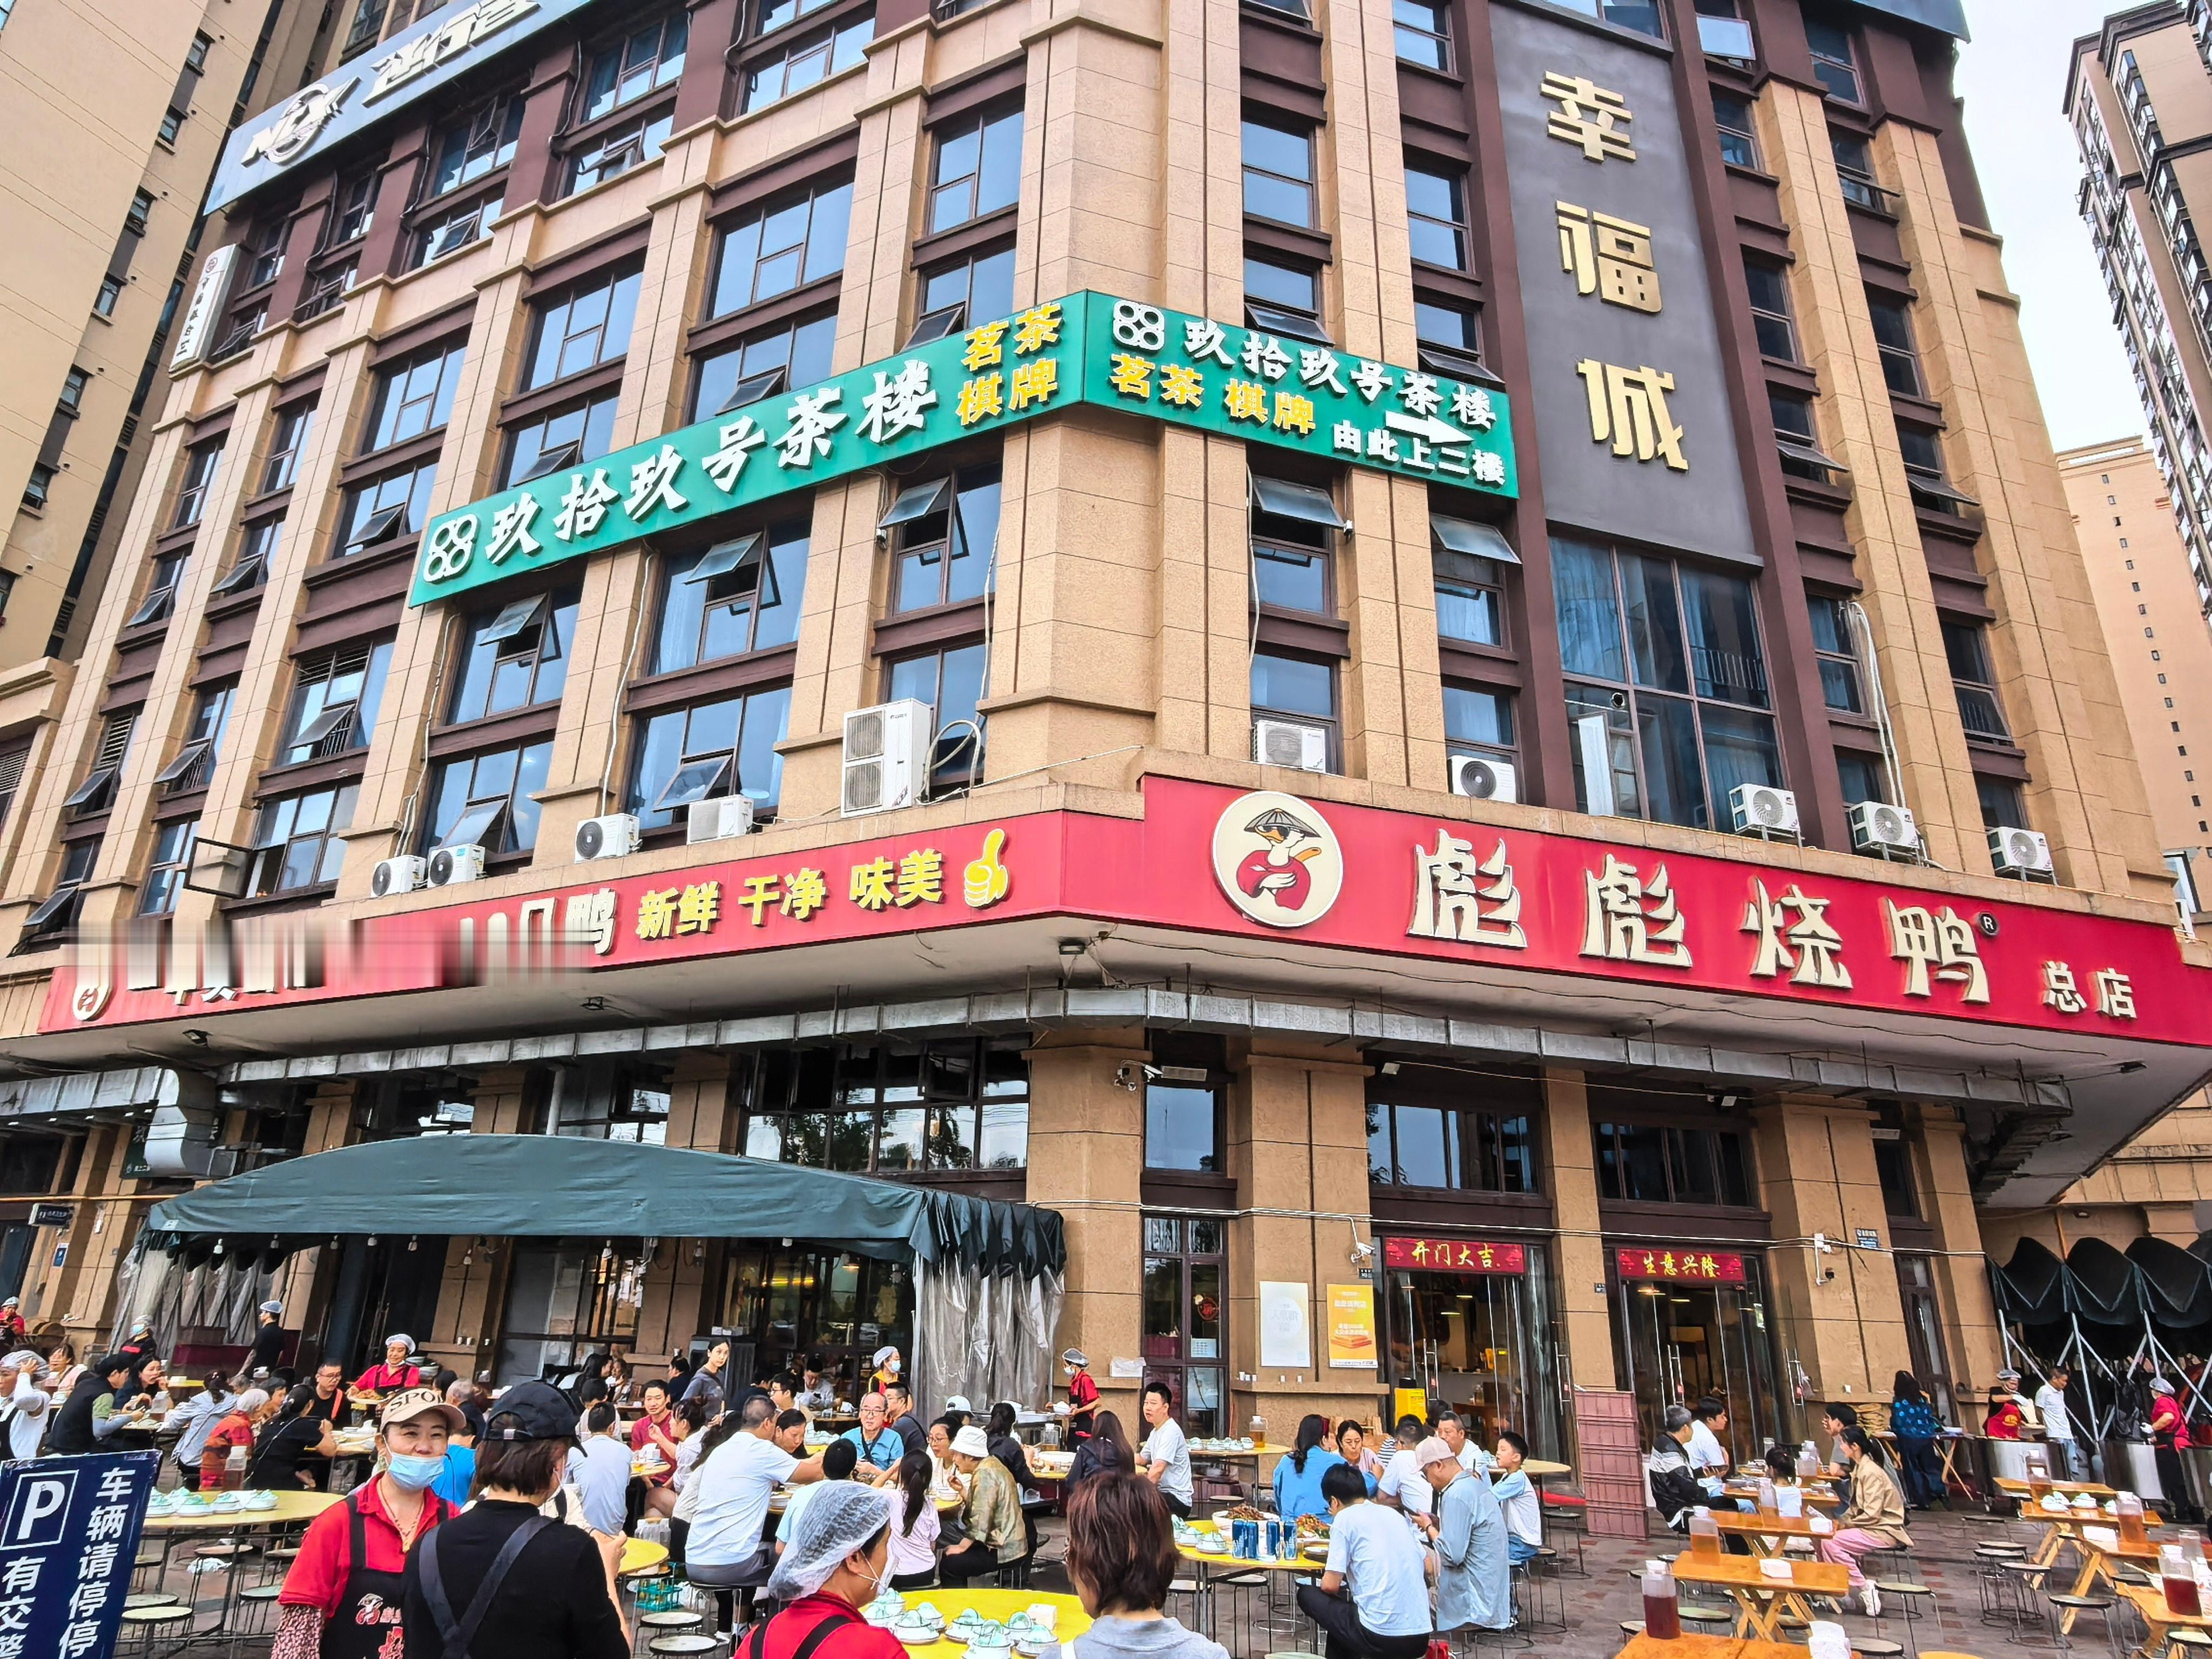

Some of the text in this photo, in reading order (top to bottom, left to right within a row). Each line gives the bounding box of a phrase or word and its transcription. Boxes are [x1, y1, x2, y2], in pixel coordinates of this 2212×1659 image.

[1540, 70, 1689, 472] 幸福城
[961, 301, 1064, 373] 茗茶
[1183, 319, 1497, 430] 玖拾玖号茶楼
[957, 357, 1060, 427] 棋牌
[1109, 353, 1316, 436] 茗茶 棋牌
[483, 359, 938, 564] 玖拾玖号茶楼
[1333, 420, 1506, 486] 由此上二楼
[635, 880, 721, 940] 新鲜
[738, 867, 827, 927] 干净
[849, 848, 945, 911] 味美
[1406, 828, 1991, 1004] 彪彪烧鸭
[2042, 960, 2137, 1019] 总店
[1412, 1240, 1494, 1267] 开门大吉
[1643, 1251, 1720, 1278] 生意兴隆
[17, 1481, 65, 1540] P
